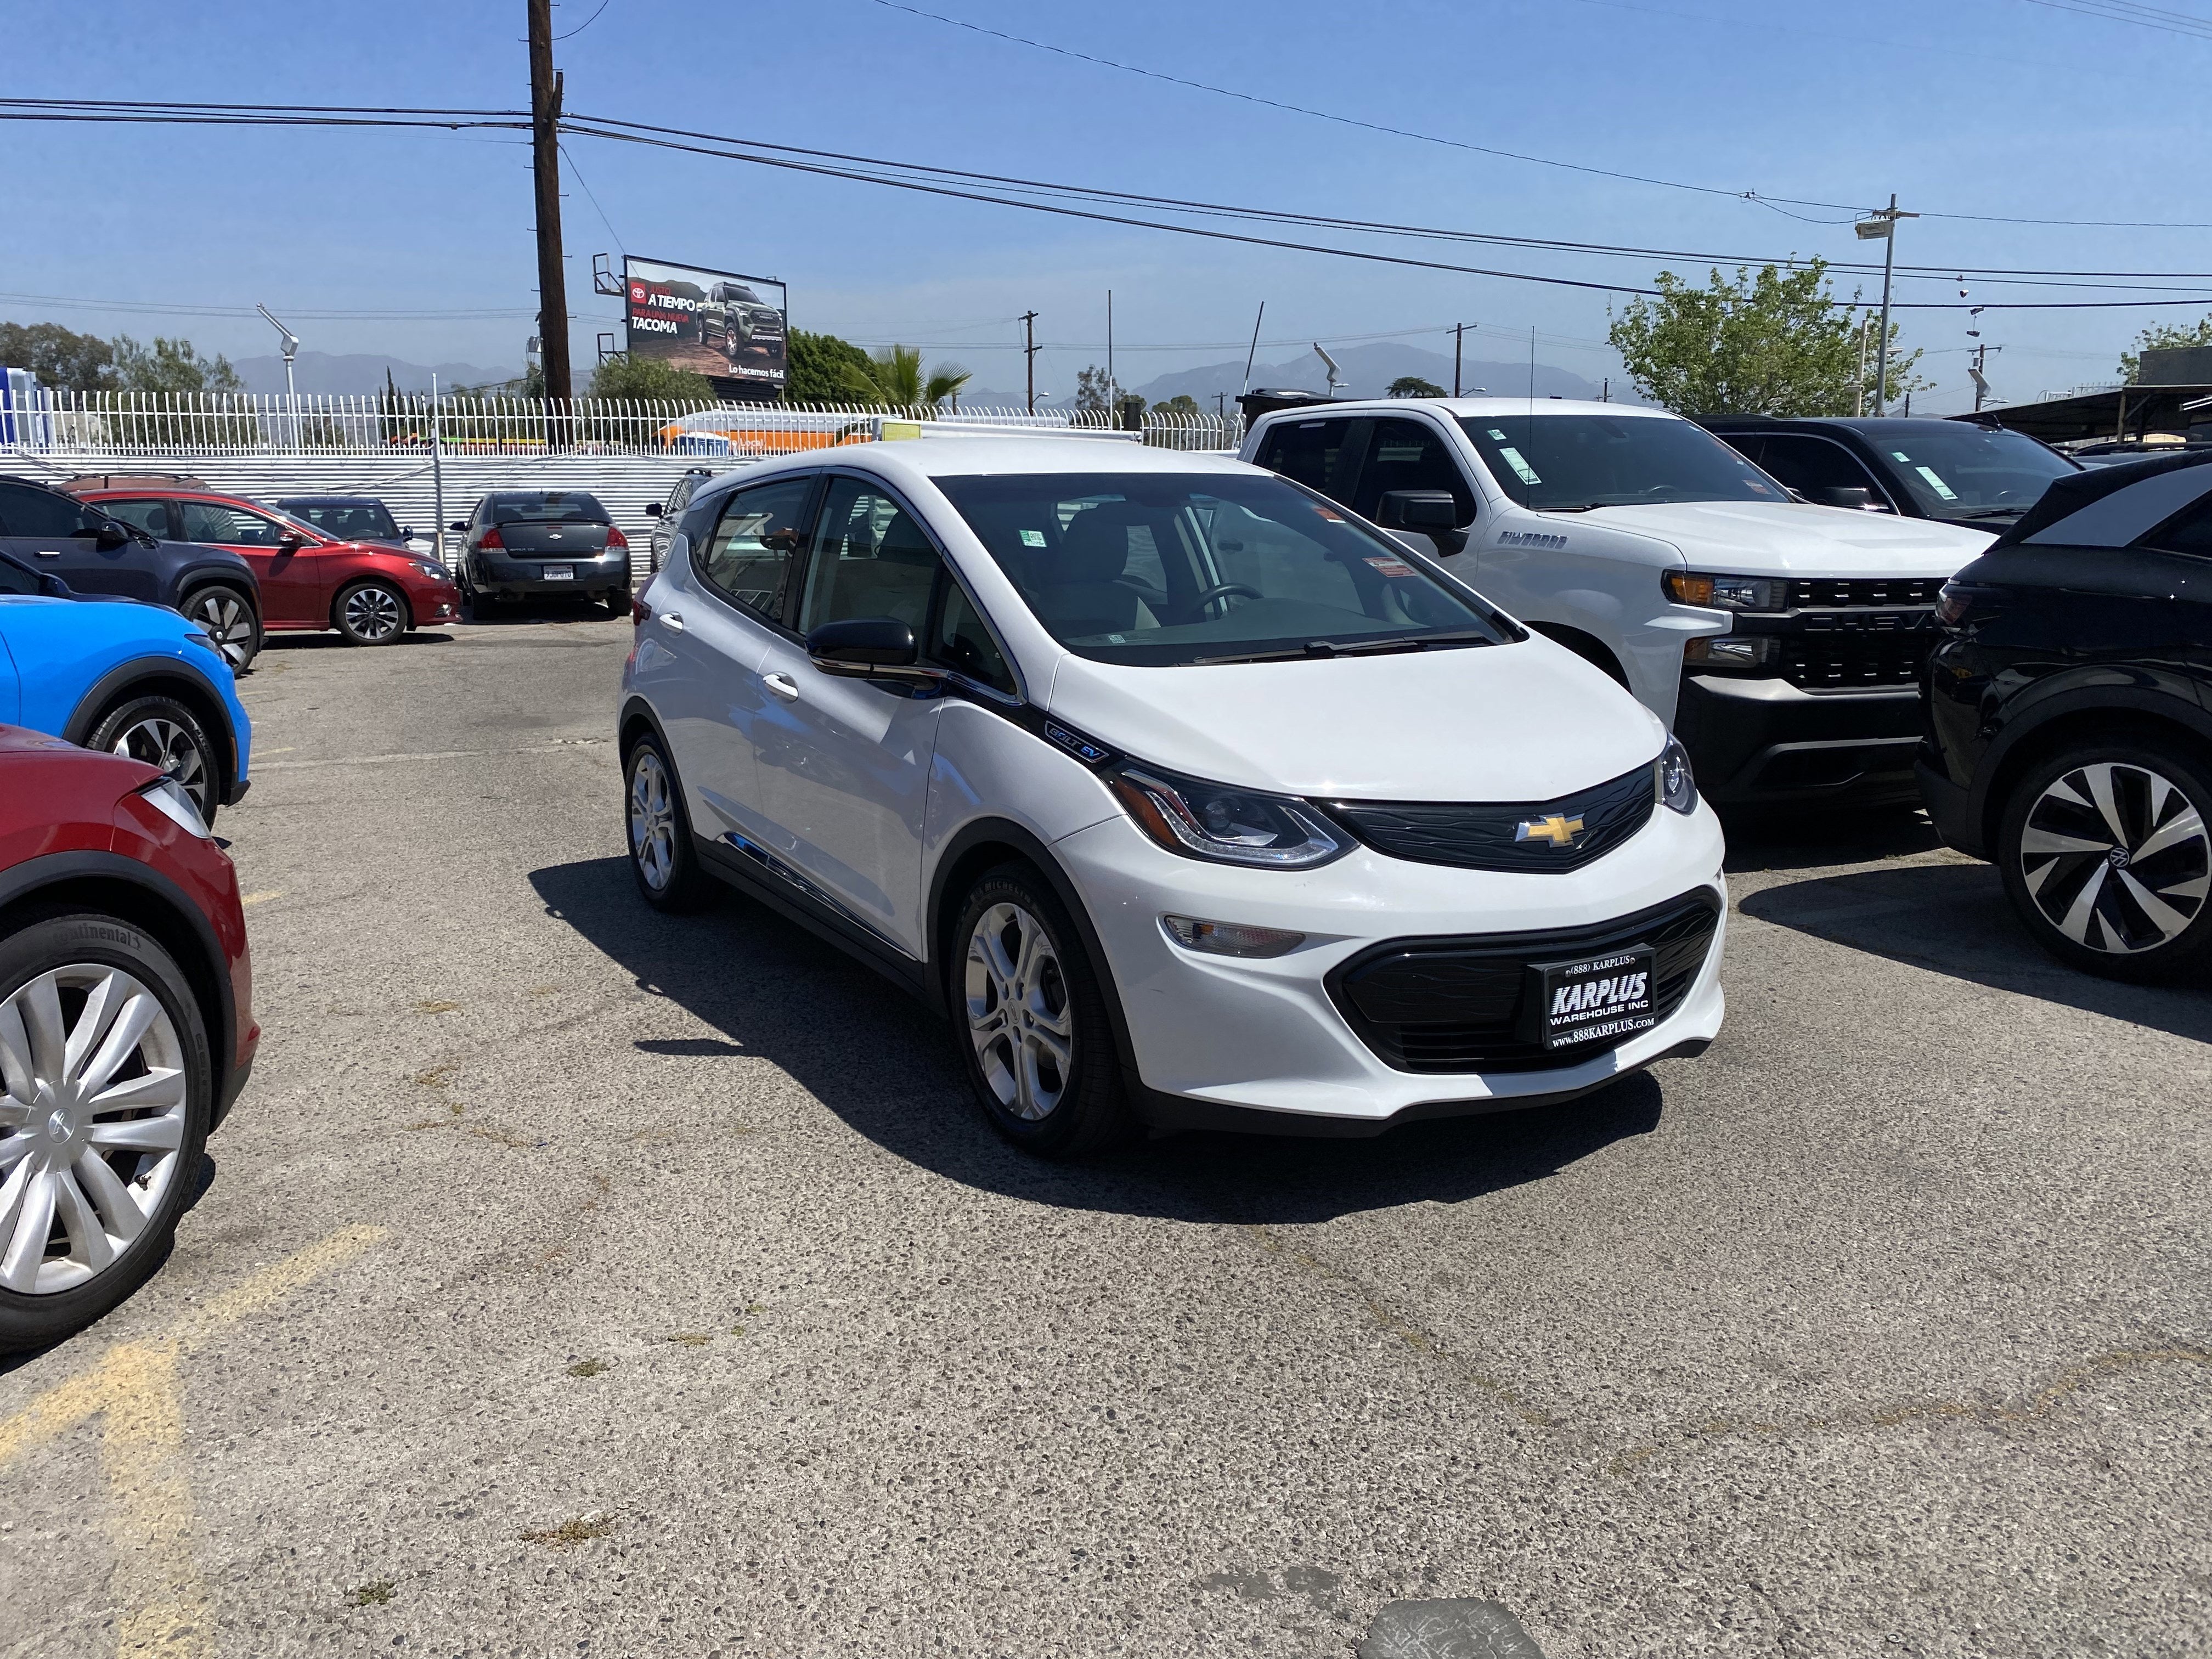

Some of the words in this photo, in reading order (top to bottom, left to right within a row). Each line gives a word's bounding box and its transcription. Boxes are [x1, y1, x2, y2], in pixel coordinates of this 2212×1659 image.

[647, 294, 657, 306] A
[657, 294, 696, 312] TIEMPO
[631, 316, 678, 334] TACOMA
[729, 364, 738, 374] Lo
[738, 365, 769, 377] hacemos
[770, 368, 785, 379] fácil
[1049, 727, 1081, 747] BOLT
[1081, 746, 1101, 757] EV
[1570, 964, 1591, 975] (888)
[1592, 955, 1630, 972] KARPLUS
[1550, 972, 1648, 1015] KARPLUS
[1550, 1003, 1625, 1026] WAREHOUSE
[1628, 1000, 1649, 1011] INC
